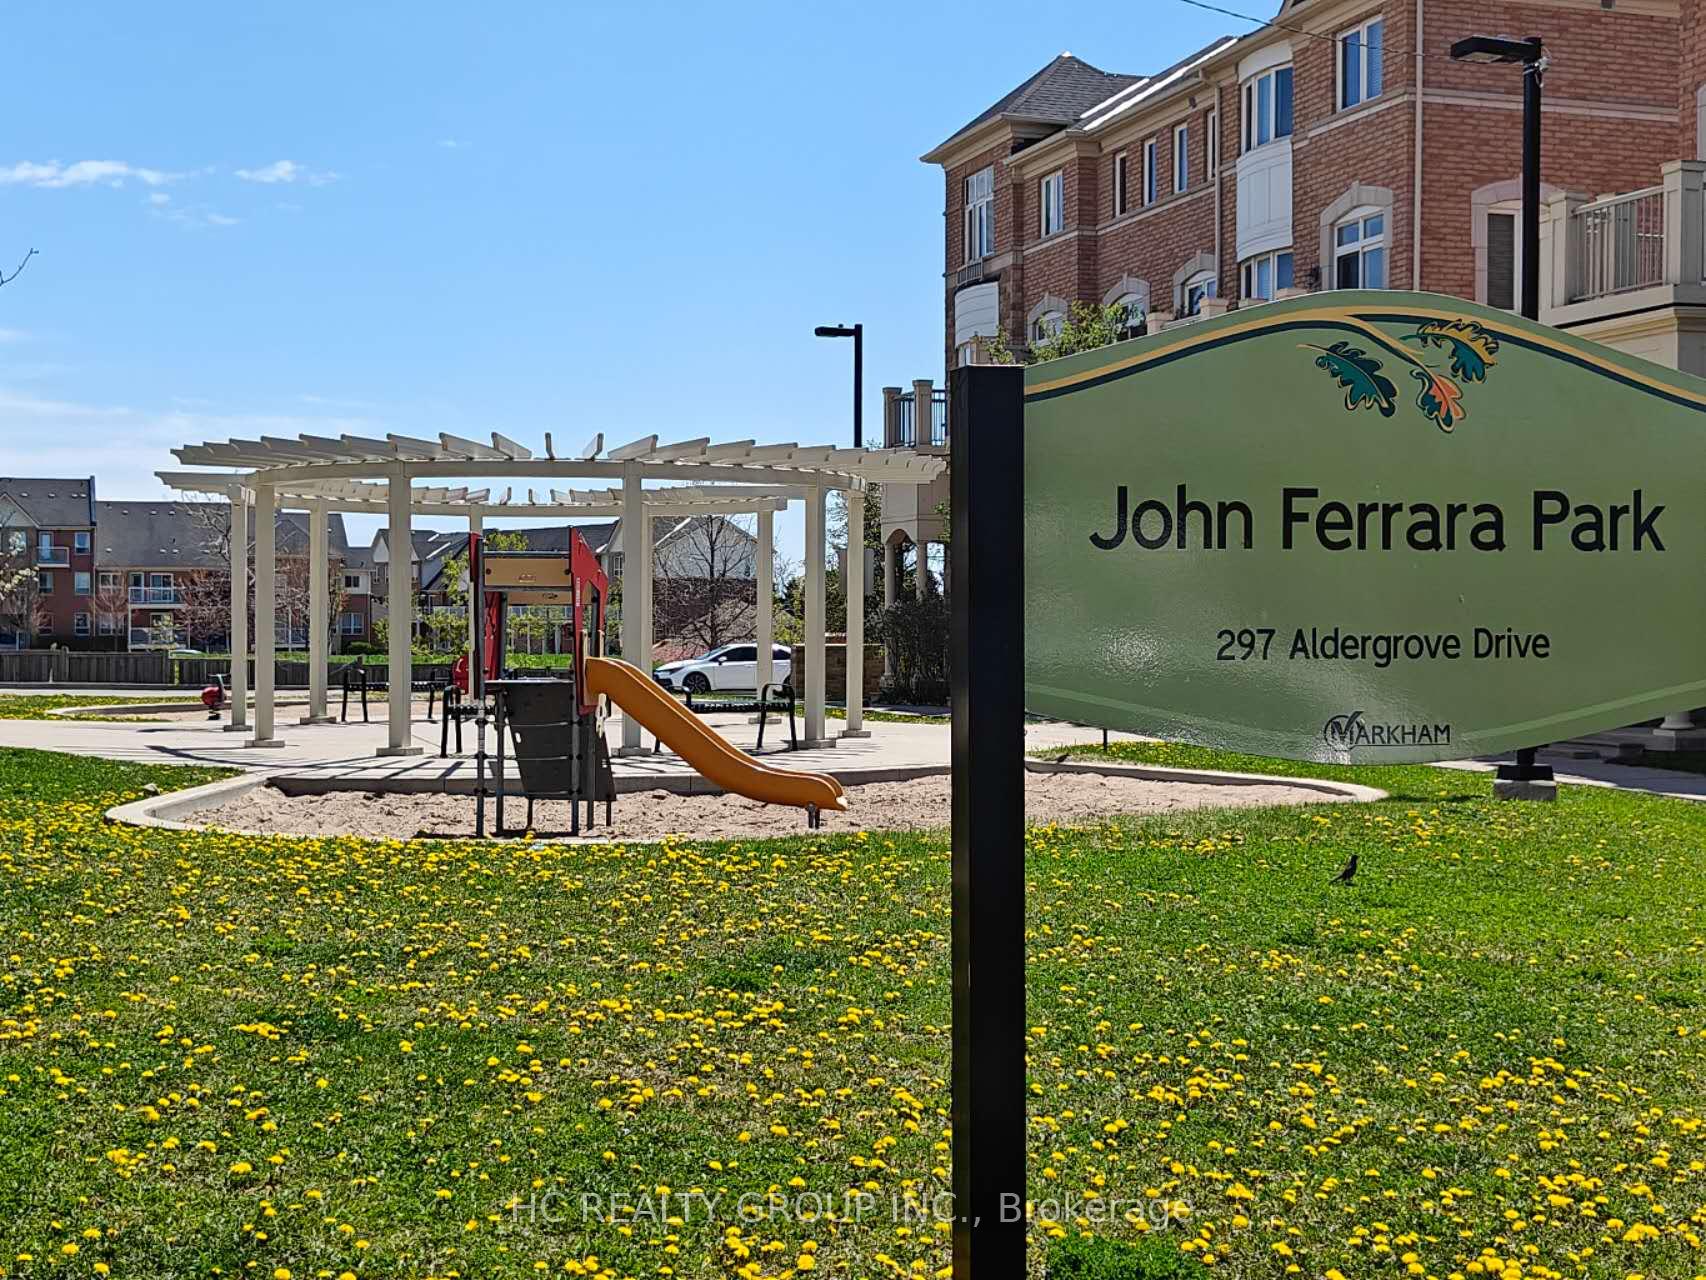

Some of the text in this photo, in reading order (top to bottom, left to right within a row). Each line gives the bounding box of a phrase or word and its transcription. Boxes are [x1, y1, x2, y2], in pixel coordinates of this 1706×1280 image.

[1089, 484, 1666, 553] John Ferrara Park
[1216, 626, 1551, 668] 297 Aldergrove Drive
[1324, 711, 1450, 751] MARKHAM
